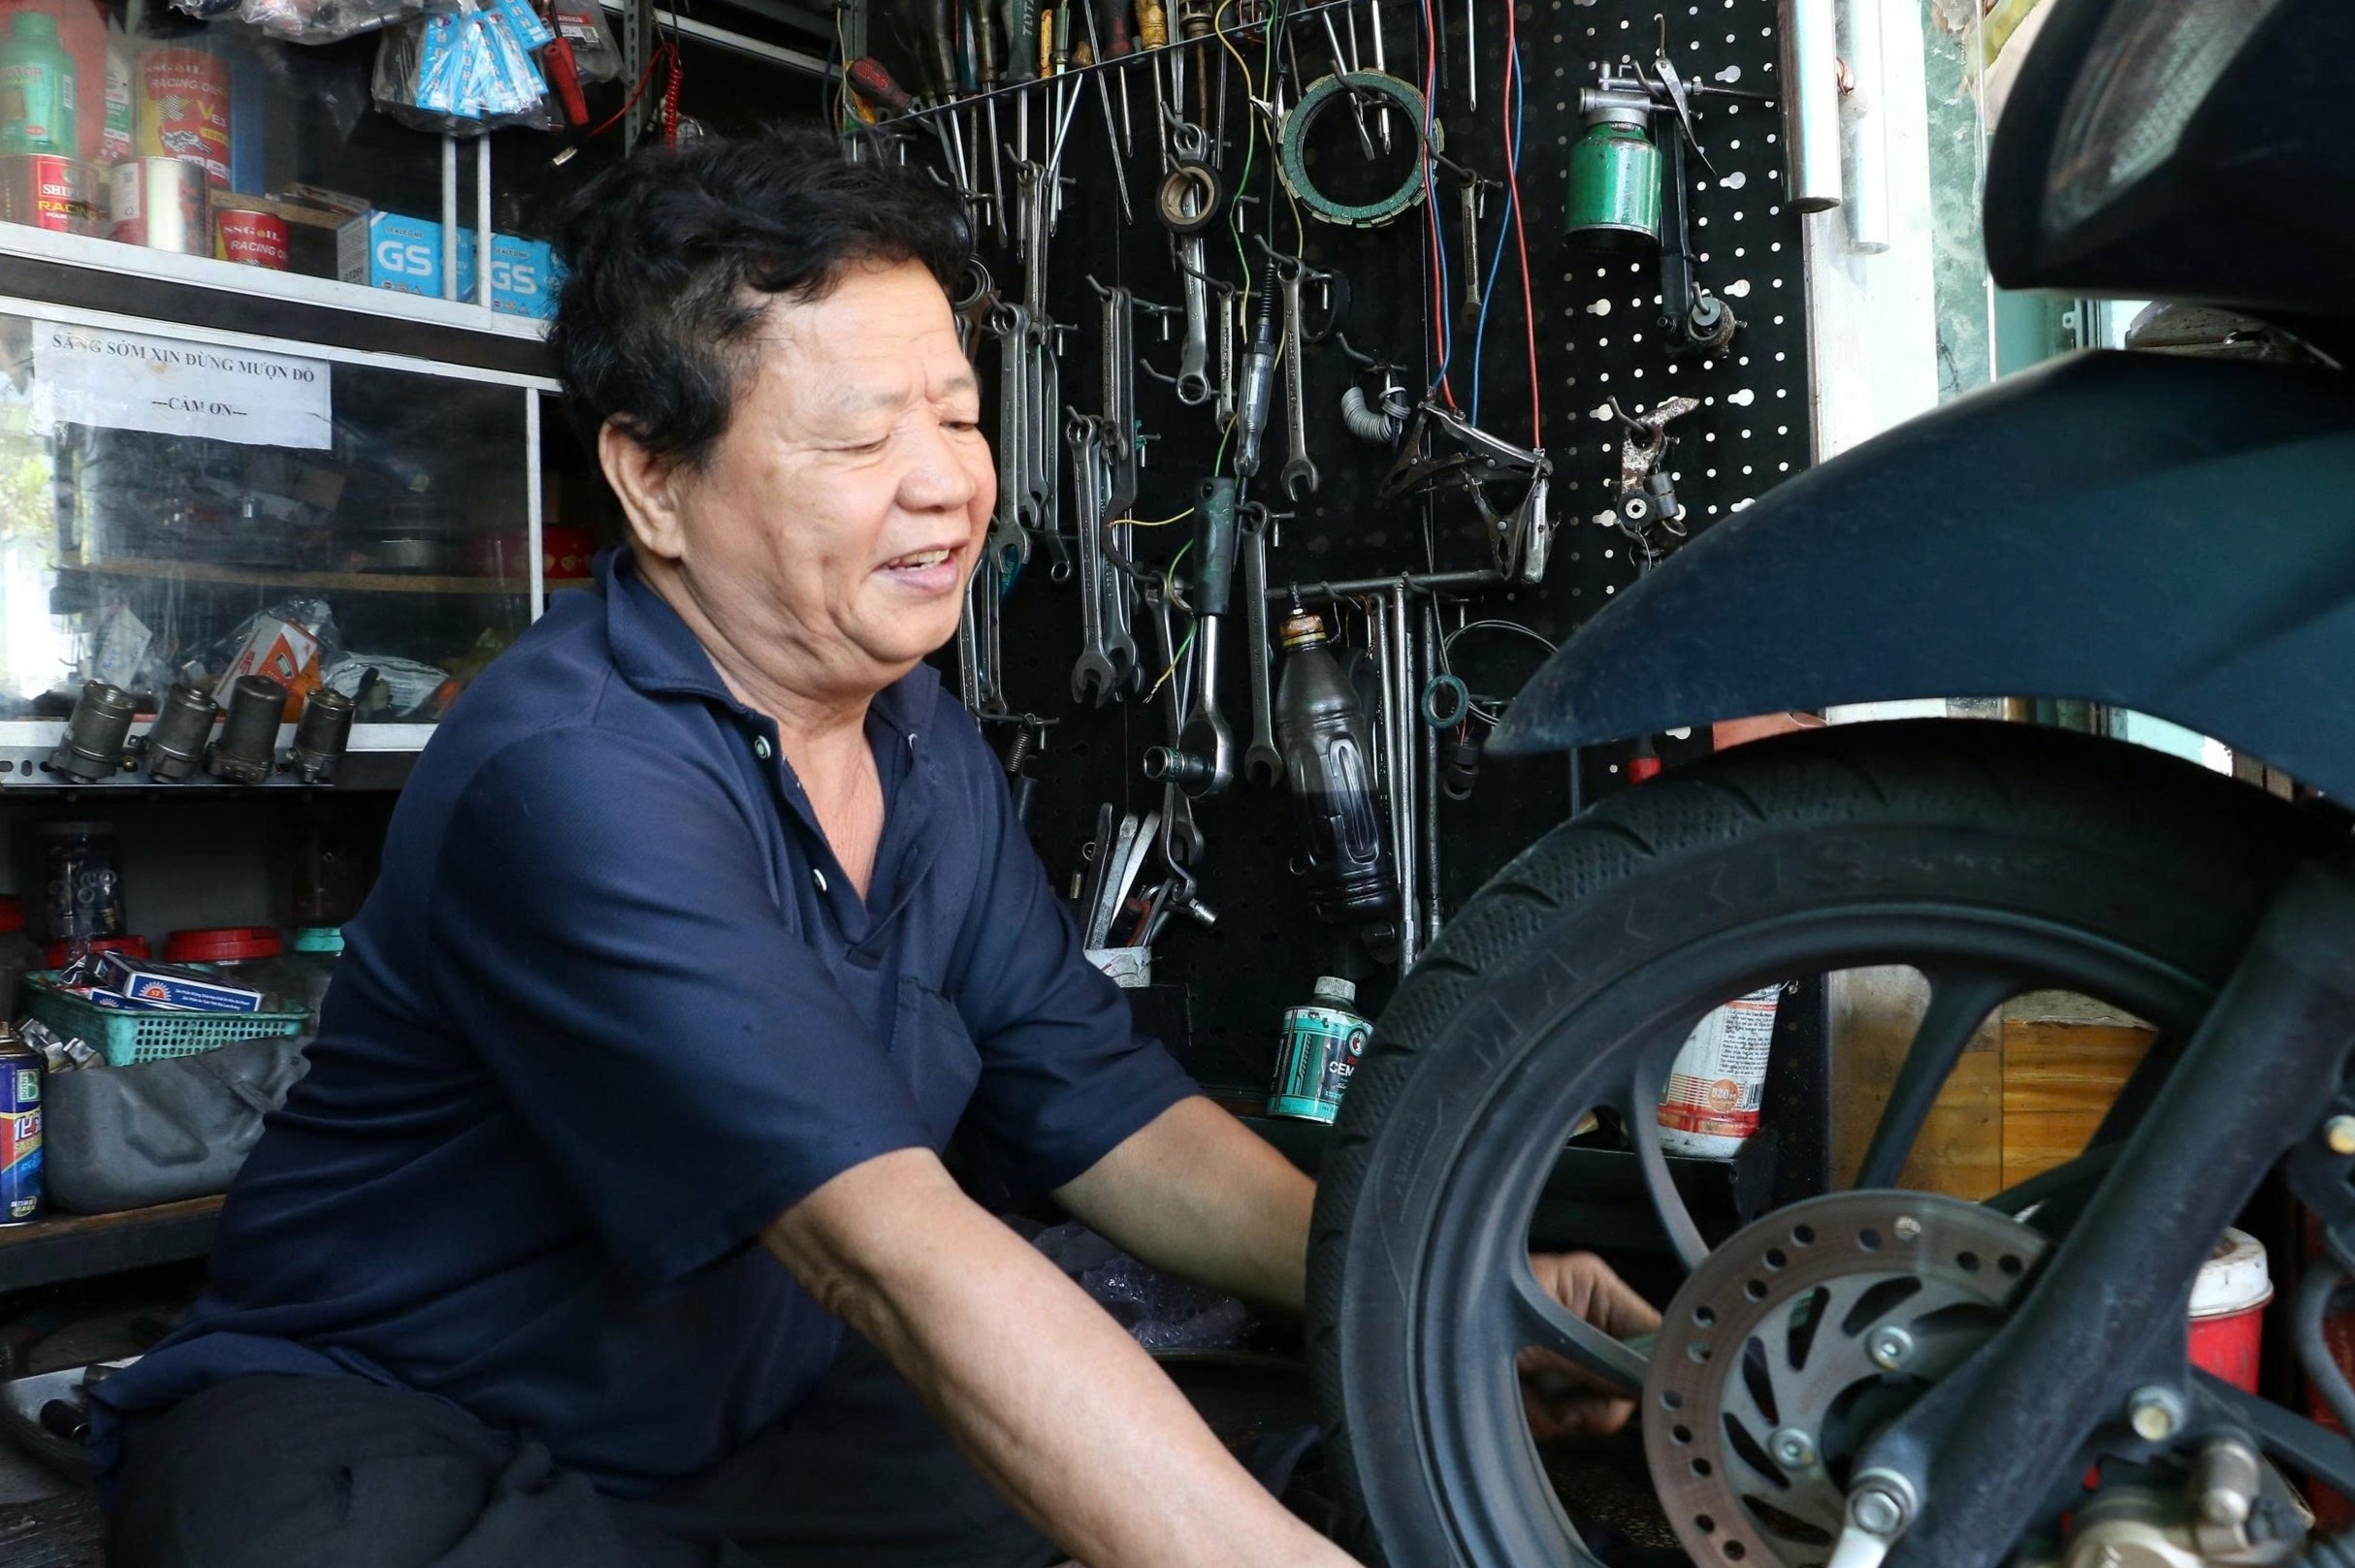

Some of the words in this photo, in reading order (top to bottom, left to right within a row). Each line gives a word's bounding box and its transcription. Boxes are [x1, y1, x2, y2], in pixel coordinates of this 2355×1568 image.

[151, 78, 198, 90] RACING
[231, 240, 275, 256] RACING
[376, 240, 433, 276] GS
[491, 260, 537, 295] GS
[151, 347, 180, 364] XIN
